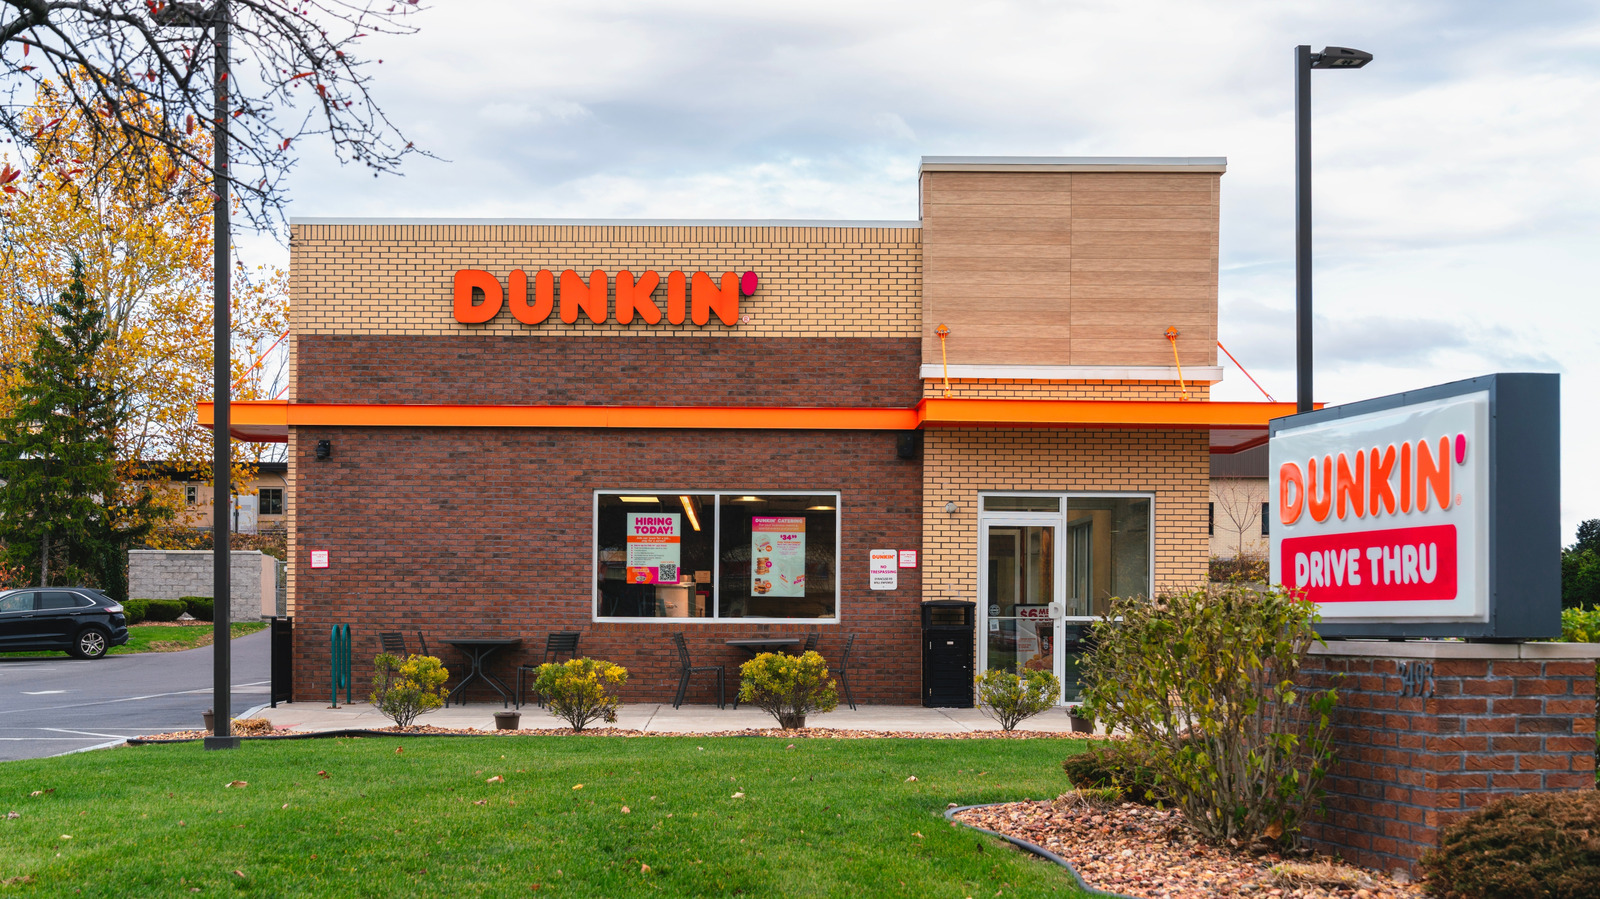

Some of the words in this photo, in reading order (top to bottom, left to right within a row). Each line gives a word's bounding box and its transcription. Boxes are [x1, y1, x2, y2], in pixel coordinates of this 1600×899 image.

[453, 268, 758, 326] DUNKIN'
[1279, 433, 1466, 525] DUNKIN'
[634, 526, 673, 534] TODAY!
[635, 517, 672, 525] HIRING
[1295, 548, 1362, 588] DRIVE
[1366, 542, 1438, 586] THRU
[1397, 662, 1434, 698] 3493
